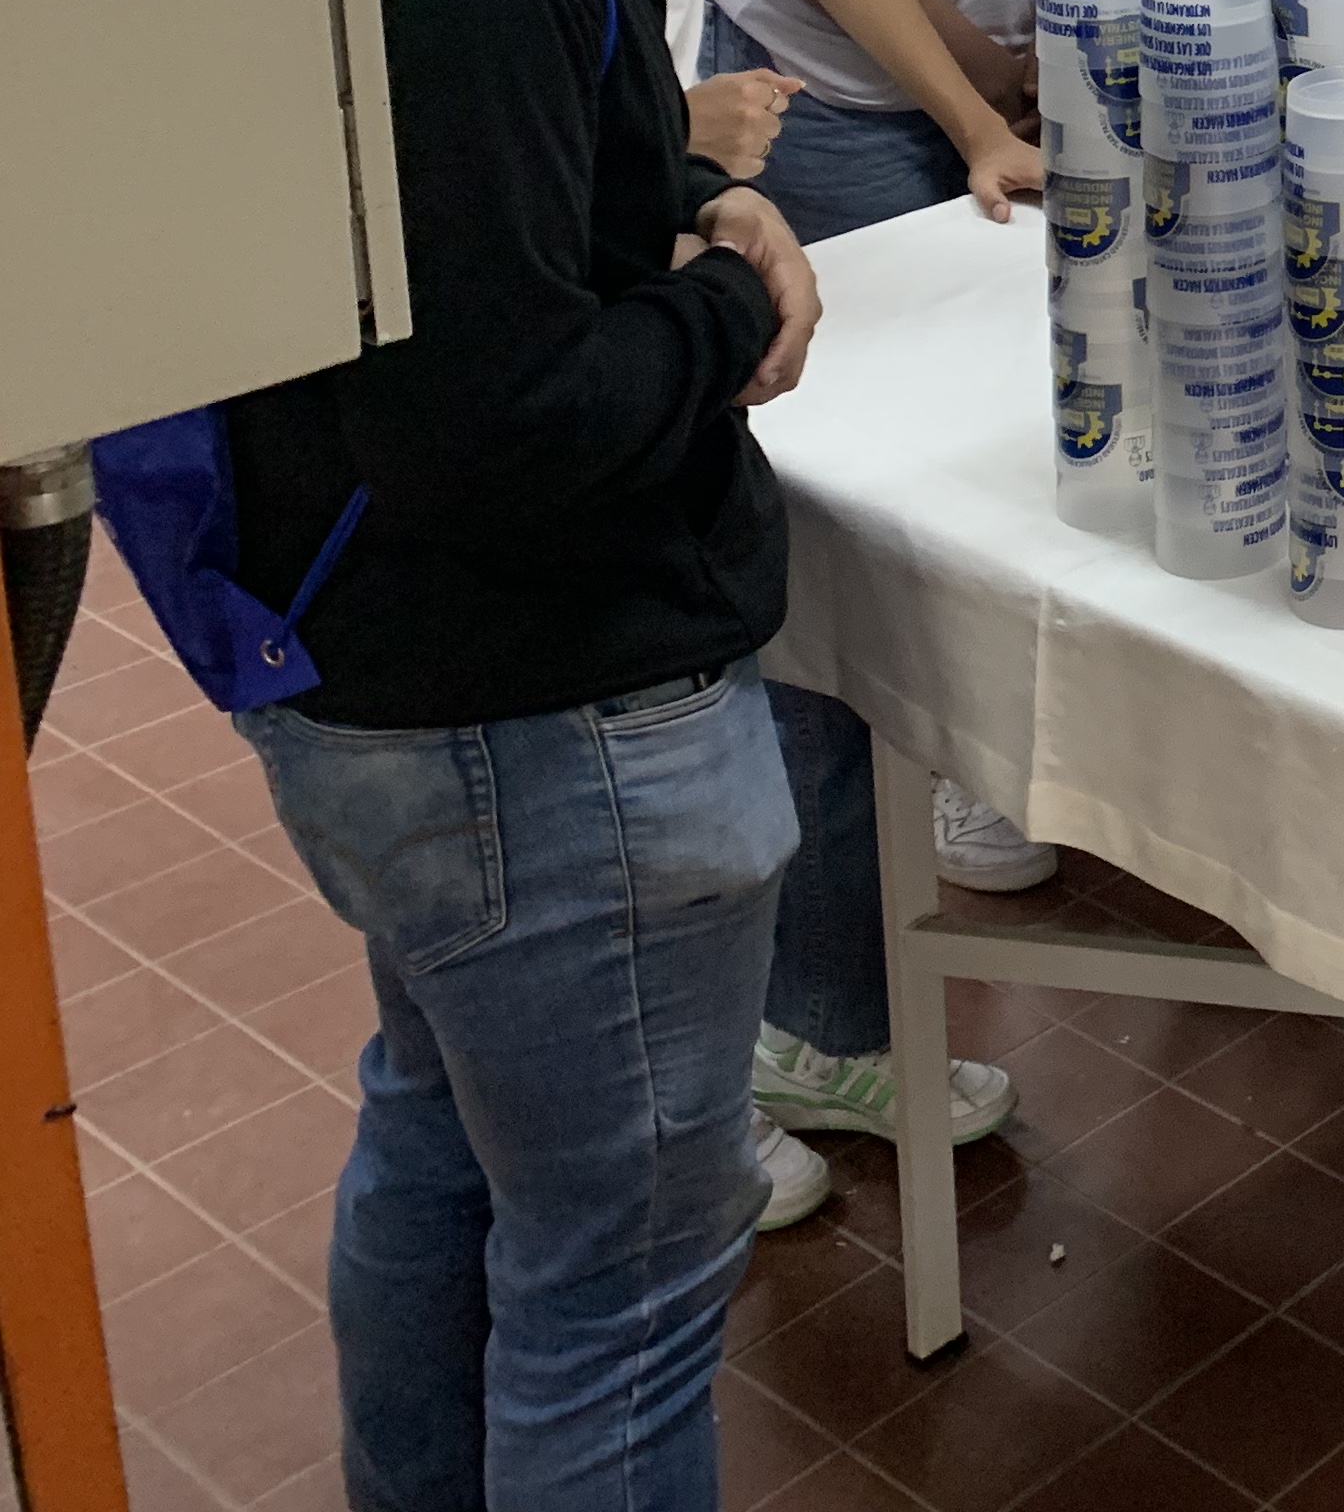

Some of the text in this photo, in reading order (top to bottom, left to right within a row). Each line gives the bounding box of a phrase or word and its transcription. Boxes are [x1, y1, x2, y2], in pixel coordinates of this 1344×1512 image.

[1197, 23, 1212, 37] LOS
[1176, 40, 1193, 57] LAS
[1195, 40, 1212, 57] QUE
